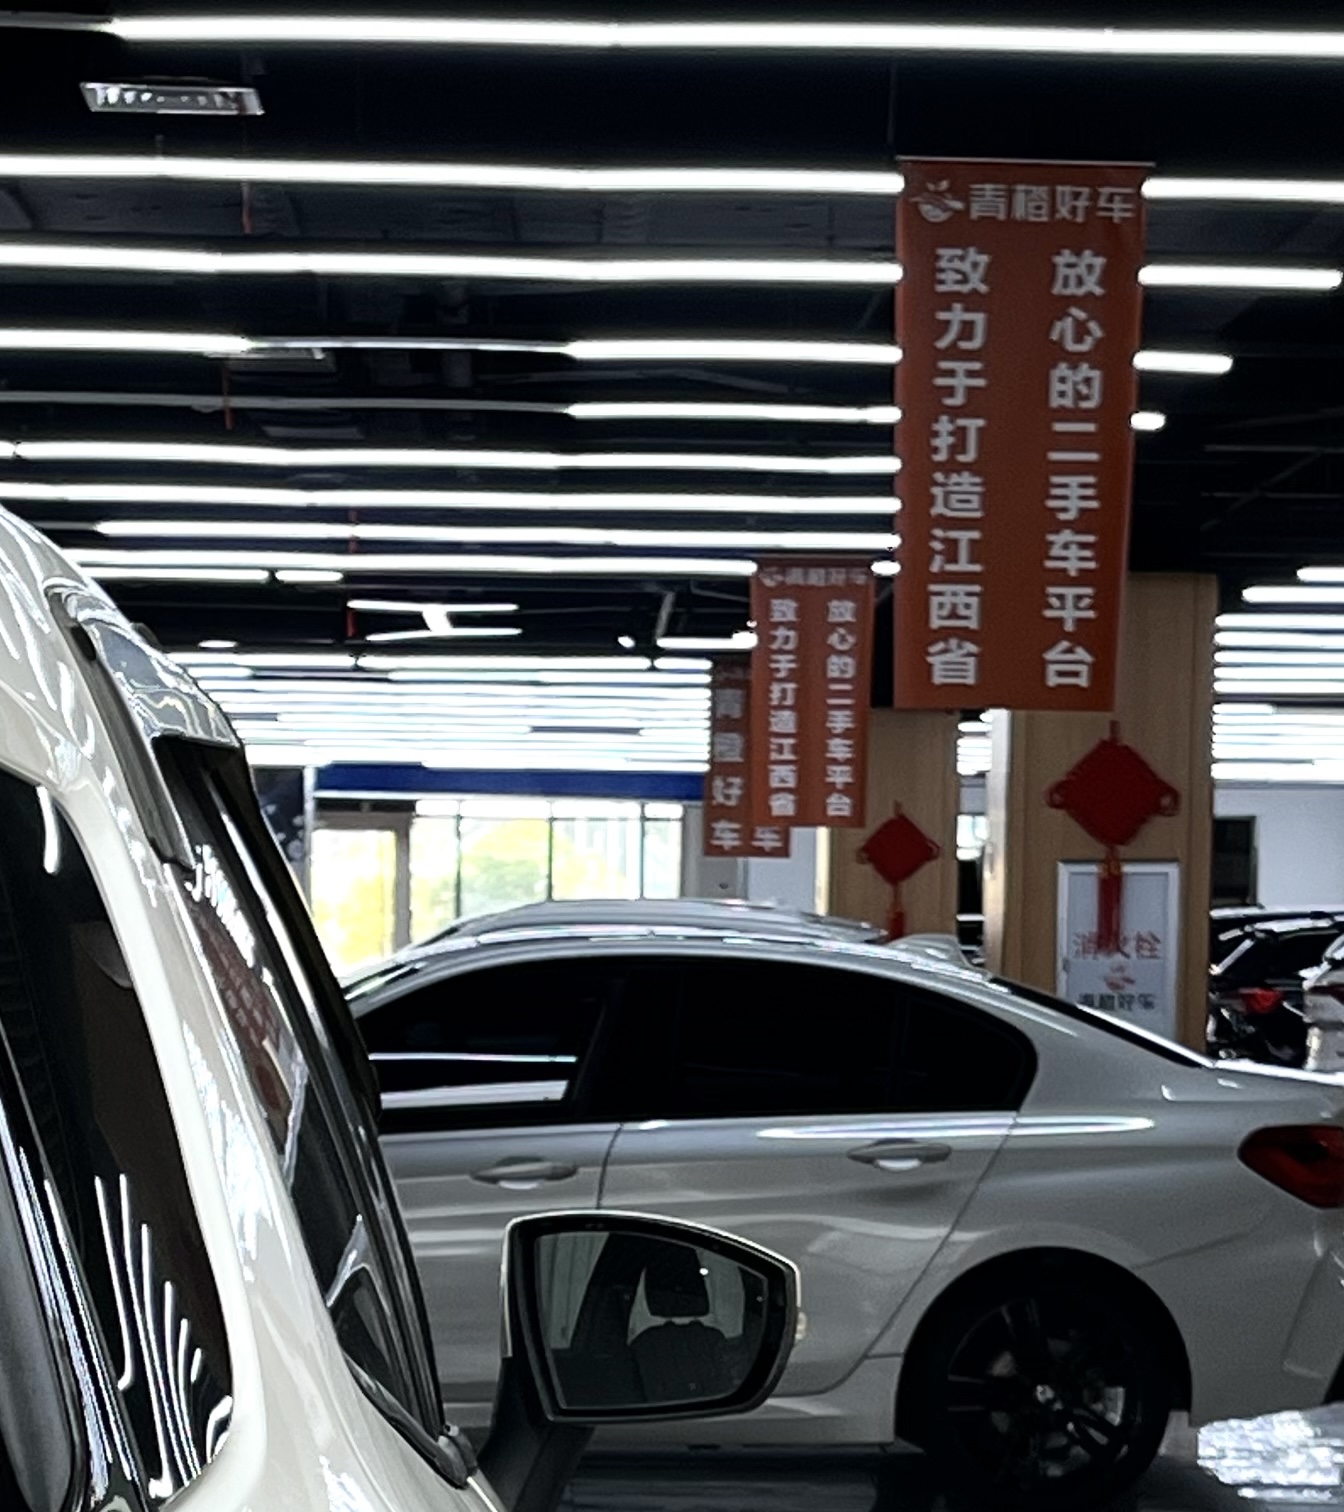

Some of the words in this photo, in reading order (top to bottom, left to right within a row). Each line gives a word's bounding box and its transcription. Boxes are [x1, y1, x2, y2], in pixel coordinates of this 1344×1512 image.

[969, 184, 1136, 223] 青橙好车
[926, 247, 991, 687] 致力于打造江西省
[1042, 249, 1108, 689] 放心的二手车平台
[767, 598, 799, 817] 致力于打造江西省
[825, 599, 857, 817] 放心的二手车平台
